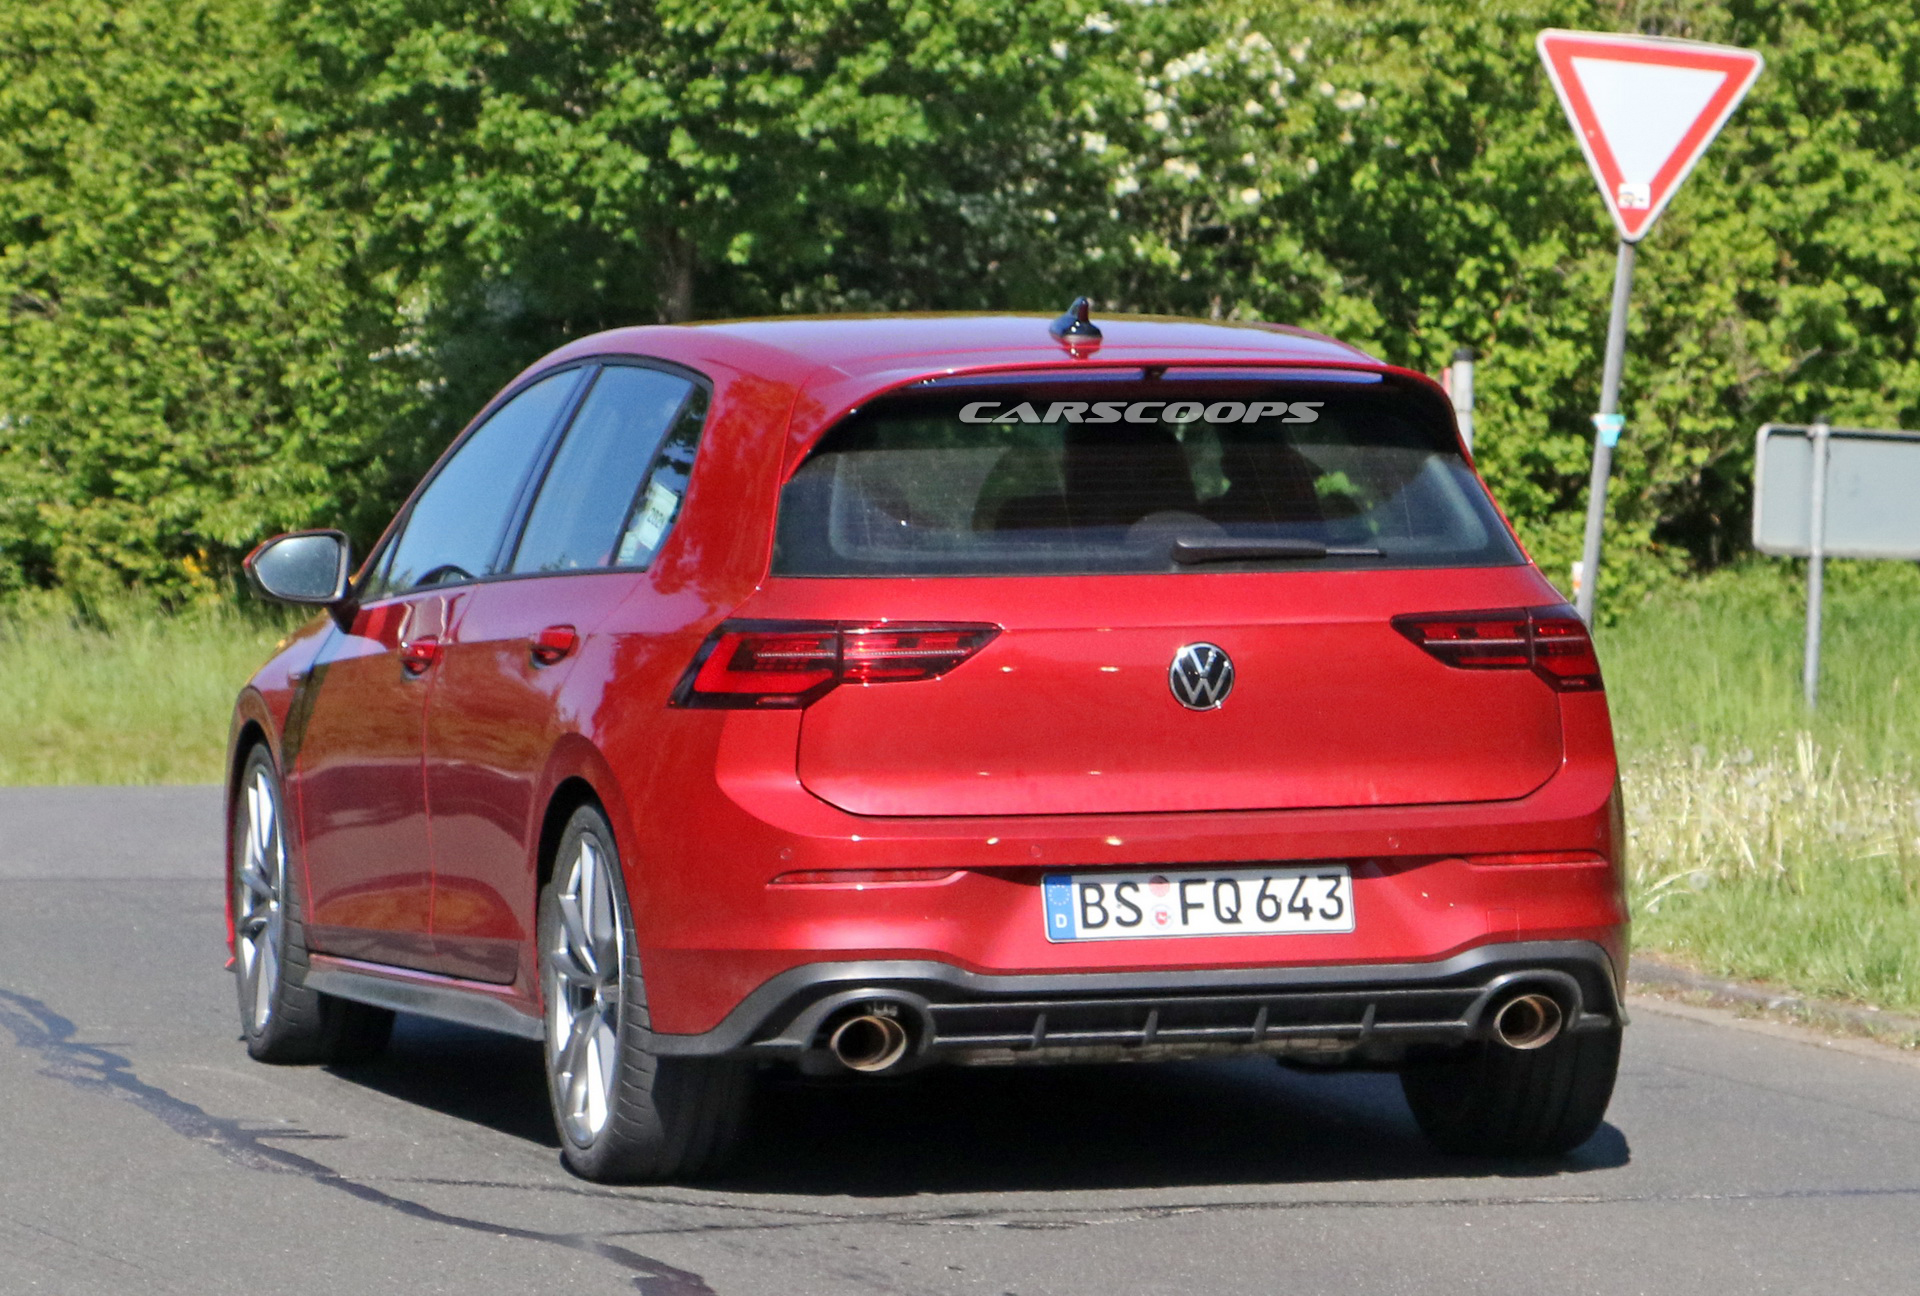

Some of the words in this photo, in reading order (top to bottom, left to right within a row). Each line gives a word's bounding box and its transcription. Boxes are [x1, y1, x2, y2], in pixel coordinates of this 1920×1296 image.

[1078, 881, 1144, 930] BS
[1178, 878, 1243, 926] FQ
[1255, 874, 1344, 923] 643
[1055, 914, 1068, 928] D
